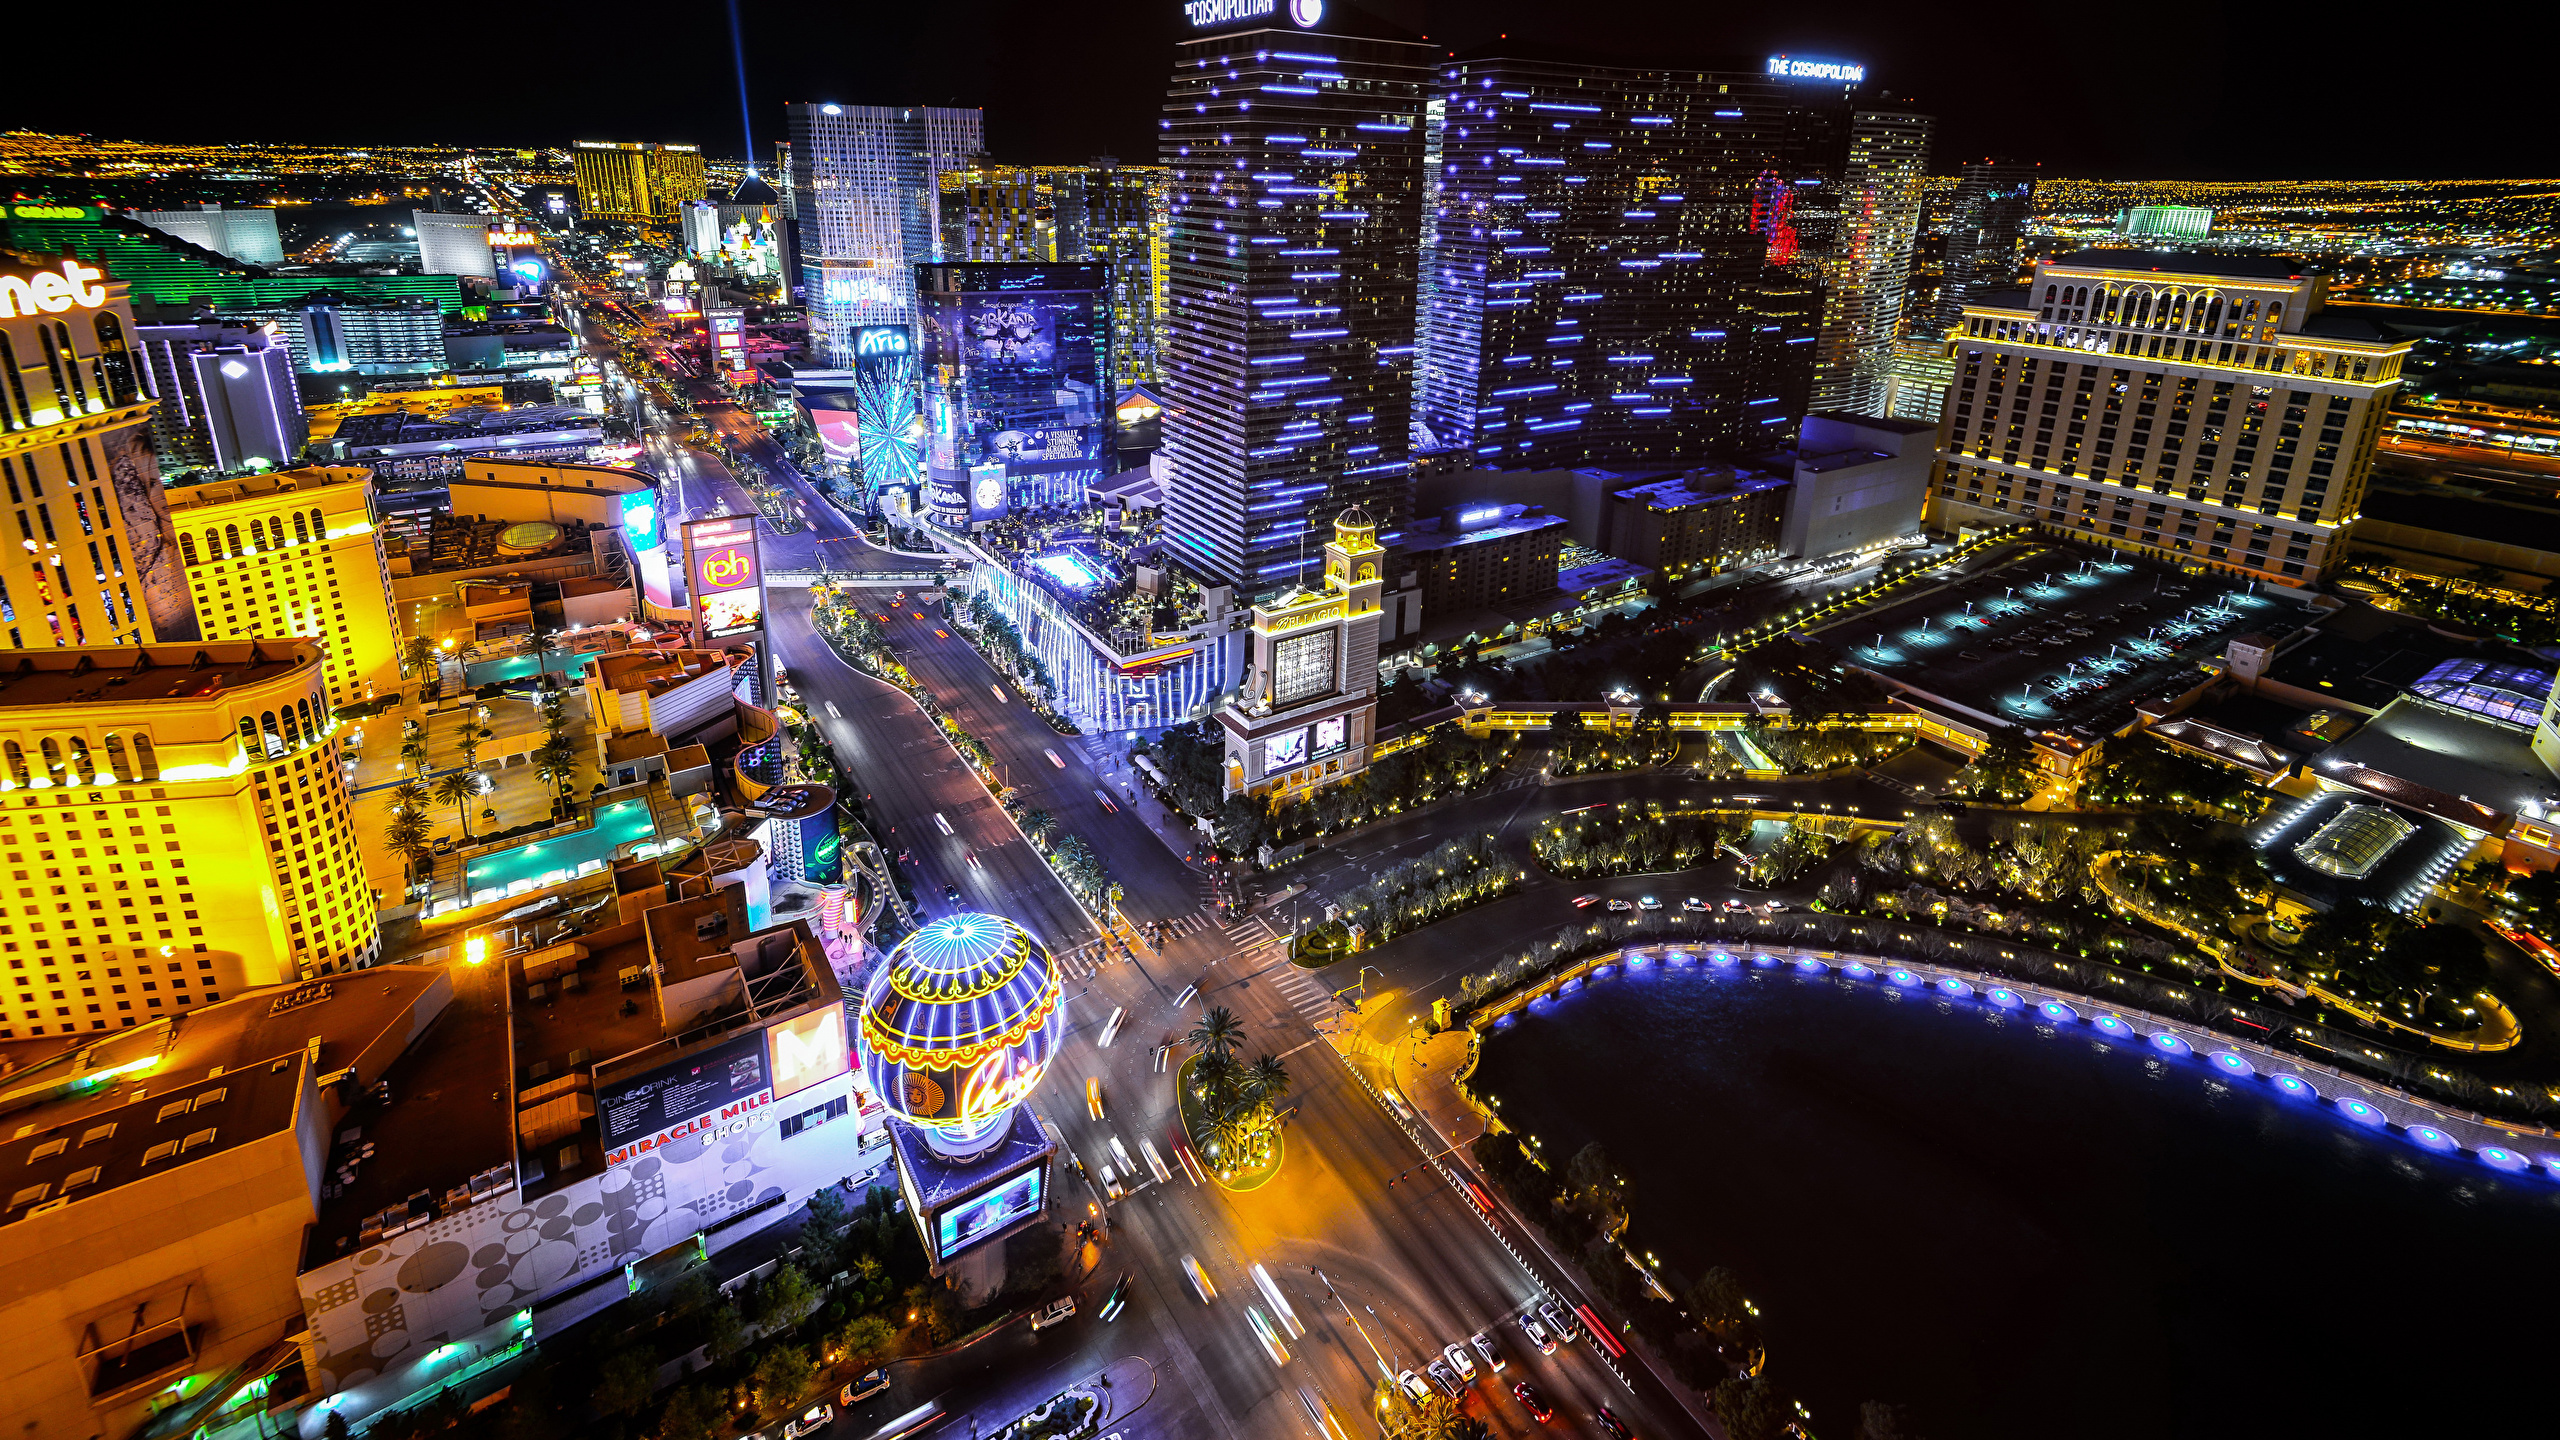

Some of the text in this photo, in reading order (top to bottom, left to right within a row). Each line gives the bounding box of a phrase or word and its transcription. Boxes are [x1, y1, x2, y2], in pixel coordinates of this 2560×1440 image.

[1184, 3, 1194, 15] THE
[1768, 58, 1864, 82] THE COSMOPOLITAN
[14, 205, 86, 219] GRAND
[488, 232, 535, 246] MGM
[0, 260, 106, 318] net
[859, 329, 906, 355] Aria
[1046, 436, 1077, 446] STUNNING
[1050, 429, 1079, 439] VISUALLY
[1041, 450, 1083, 461] SPECTACULAR
[1045, 443, 1079, 454] ACROBATIC
[708, 549, 750, 585] ph
[776, 1011, 841, 1081] M
[606, 1074, 678, 1108] DINE DRINK
[606, 1115, 712, 1167] MIRACLE
[721, 1091, 770, 1121] MILE
[701, 1109, 772, 1146] SHOPS
